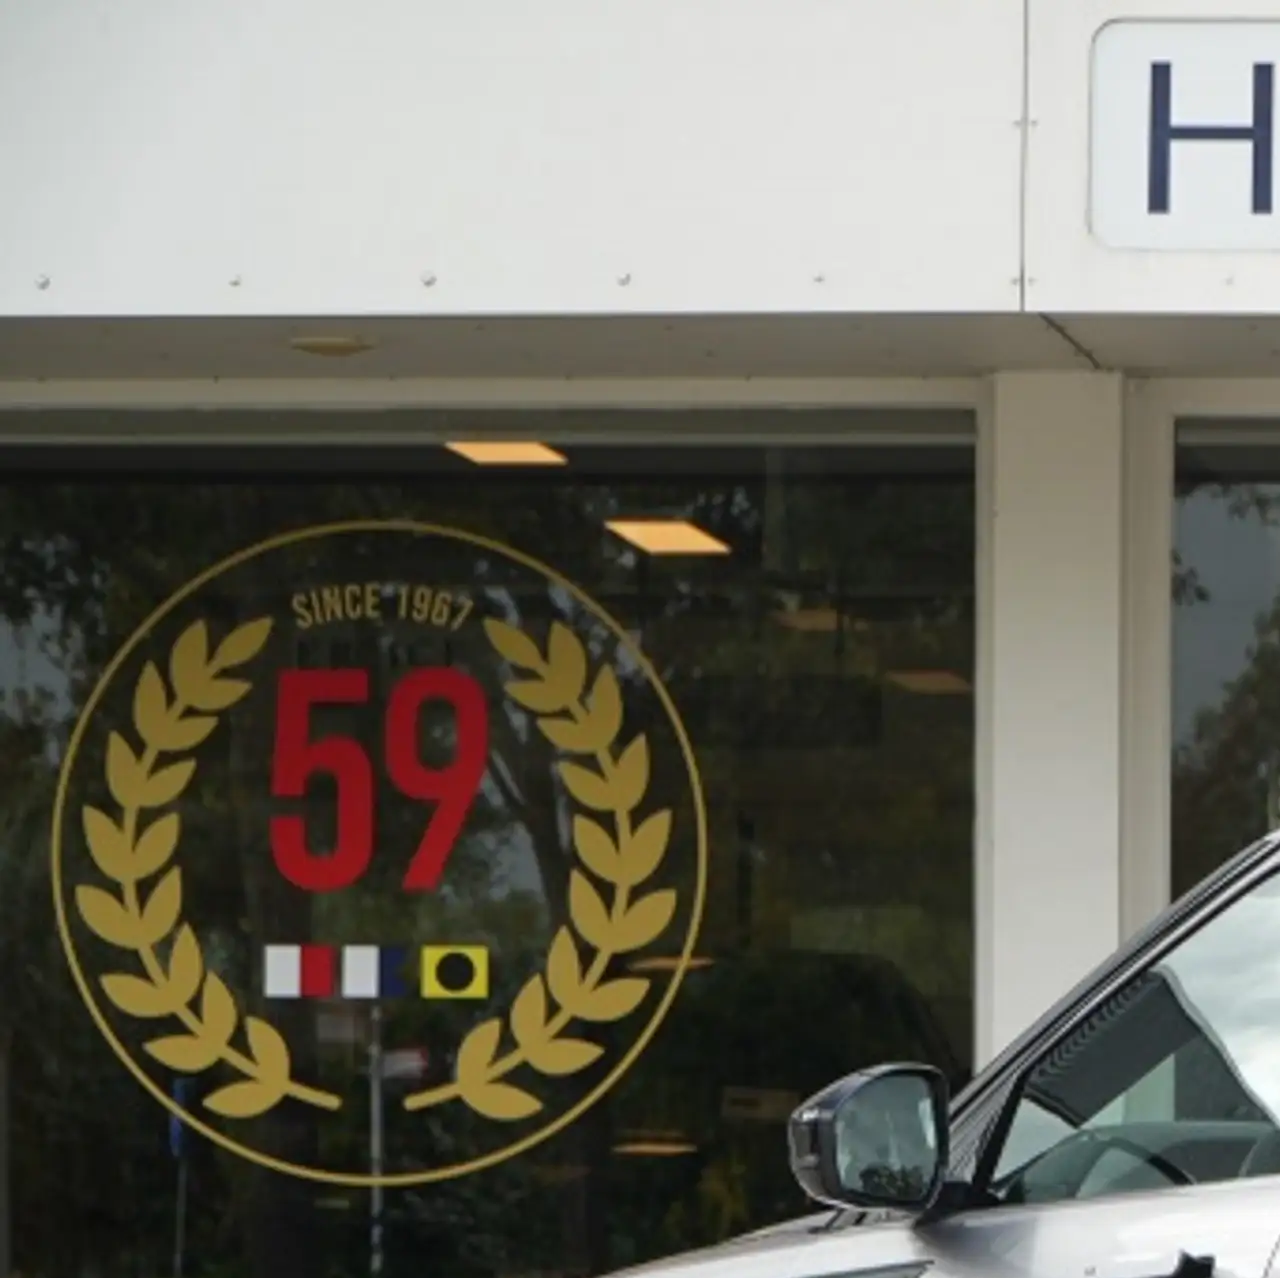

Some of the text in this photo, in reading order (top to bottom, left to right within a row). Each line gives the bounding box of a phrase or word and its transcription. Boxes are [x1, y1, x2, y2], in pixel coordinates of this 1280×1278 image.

[291, 582, 474, 631] SINCE 1967
[269, 667, 489, 892] 59
